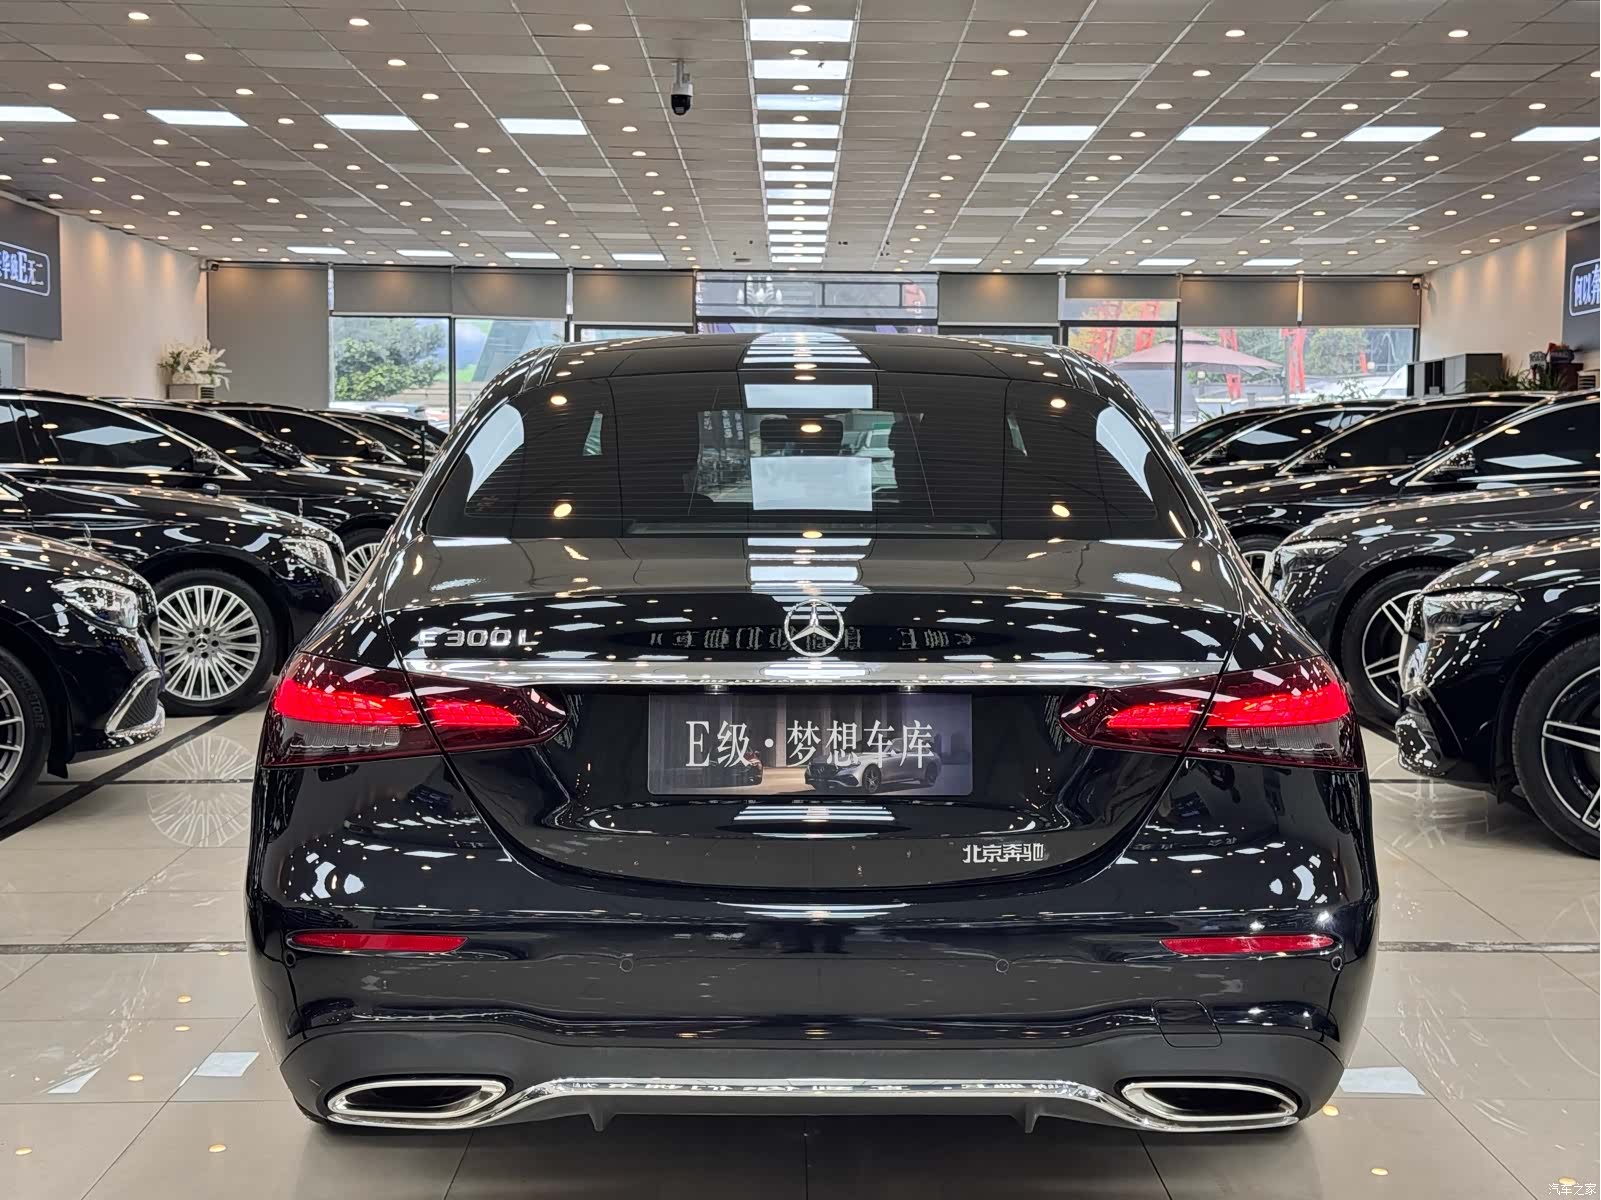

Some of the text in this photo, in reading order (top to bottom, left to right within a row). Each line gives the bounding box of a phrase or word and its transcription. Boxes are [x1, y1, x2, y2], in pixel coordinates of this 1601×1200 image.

[418, 629, 438, 647] E
[962, 843, 1045, 863] 北京奔驰
